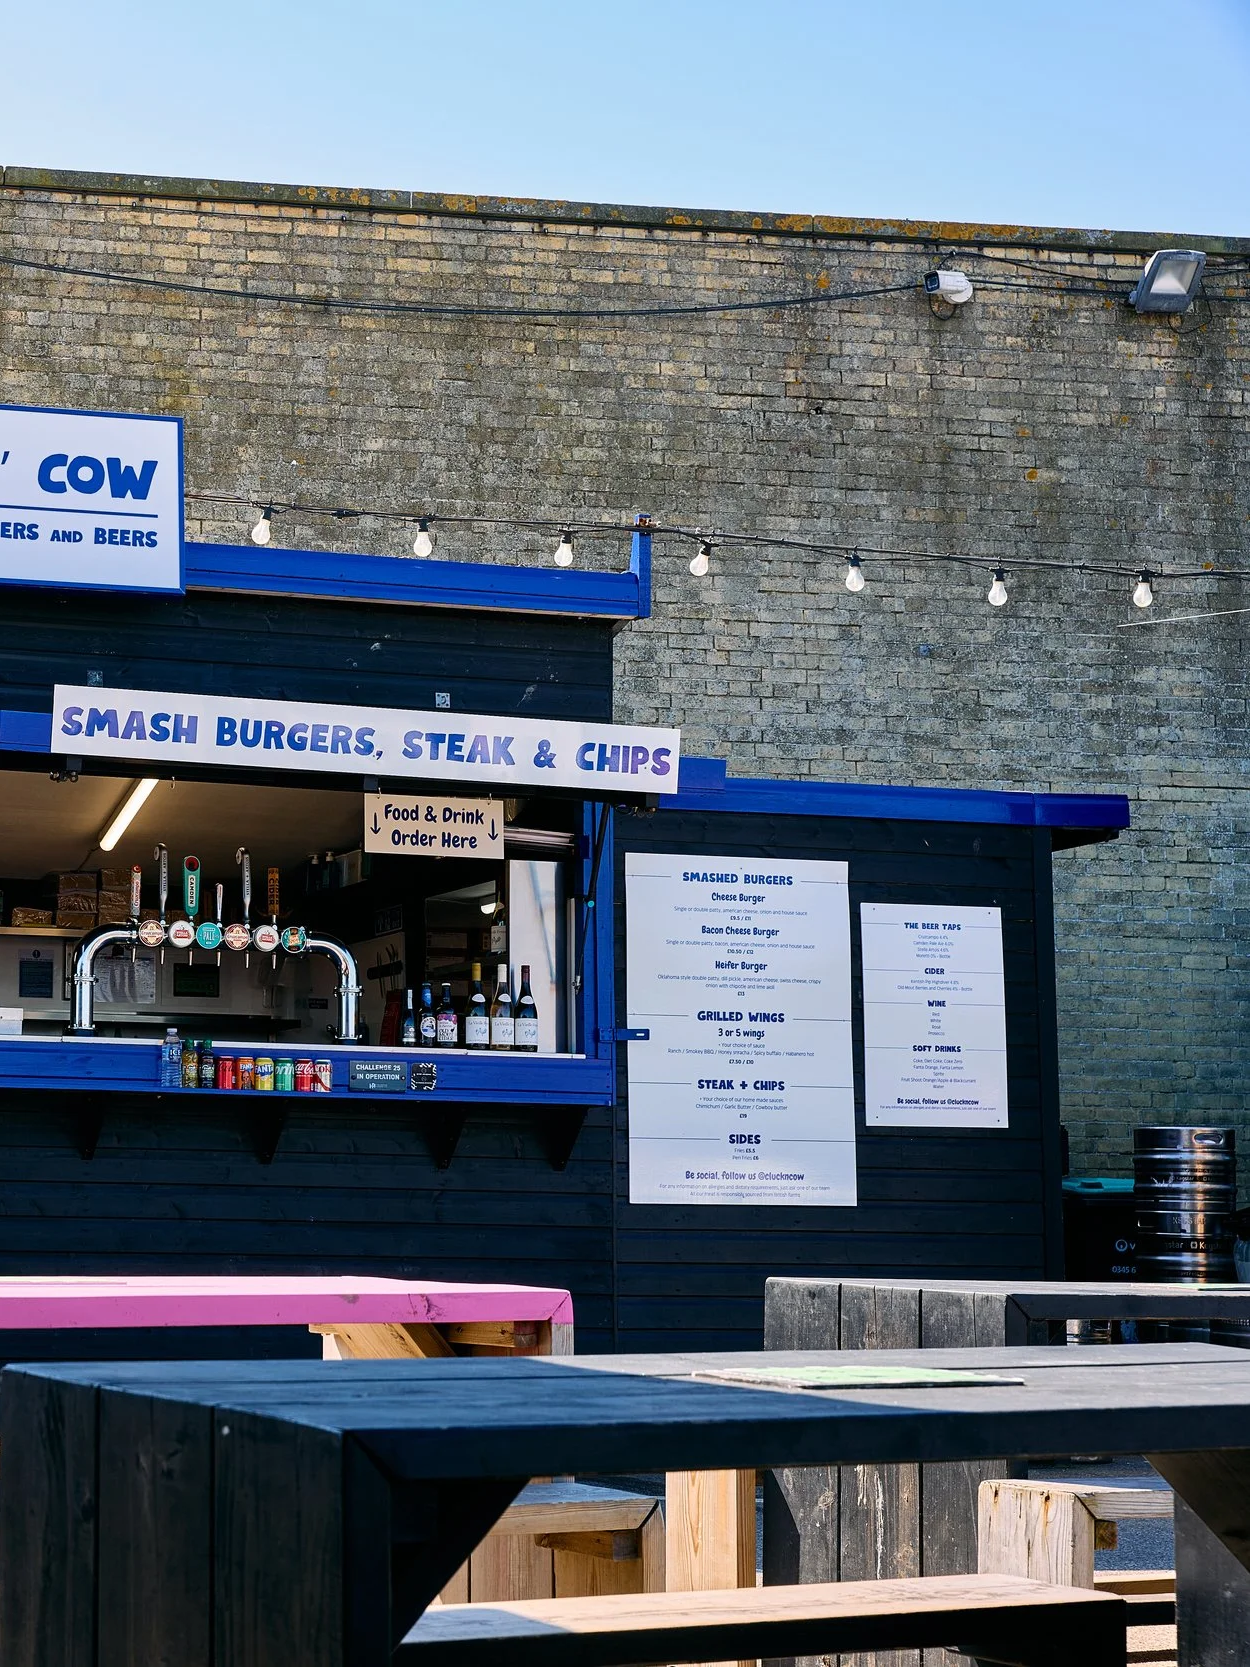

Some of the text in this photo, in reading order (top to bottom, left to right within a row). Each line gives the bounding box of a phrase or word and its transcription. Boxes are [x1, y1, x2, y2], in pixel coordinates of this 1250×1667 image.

[37, 454, 158, 500] COW
[50, 529, 83, 543] AND
[94, 528, 158, 548] BEERS
[61, 706, 672, 776] SMASH BURGERS, STEAK & CHIPS
[384, 803, 485, 825] Food & Drink
[391, 831, 478, 849] Order Here
[683, 872, 793, 885] SMASHED BURGERS
[712, 892, 765, 905] Cheese Burger
[702, 926, 779, 938] Bacon Cheese Burger
[716, 961, 768, 973] Heifer Burger
[698, 1011, 784, 1023] GRILLED WINGS
[718, 1028, 723, 1036] 3
[736, 1029, 741, 1037] 5
[743, 1029, 764, 1040] wings
[393, 1064, 401, 1072] 25
[365, 1073, 400, 1081] OPERATION
[698, 1079, 785, 1091] STEAK + CHIPS
[729, 1134, 761, 1144] SIDES
[686, 1171, 694, 1179] Be
[722, 1171, 746, 1180] follow
[758, 1172, 804, 1180] @cluckncow
